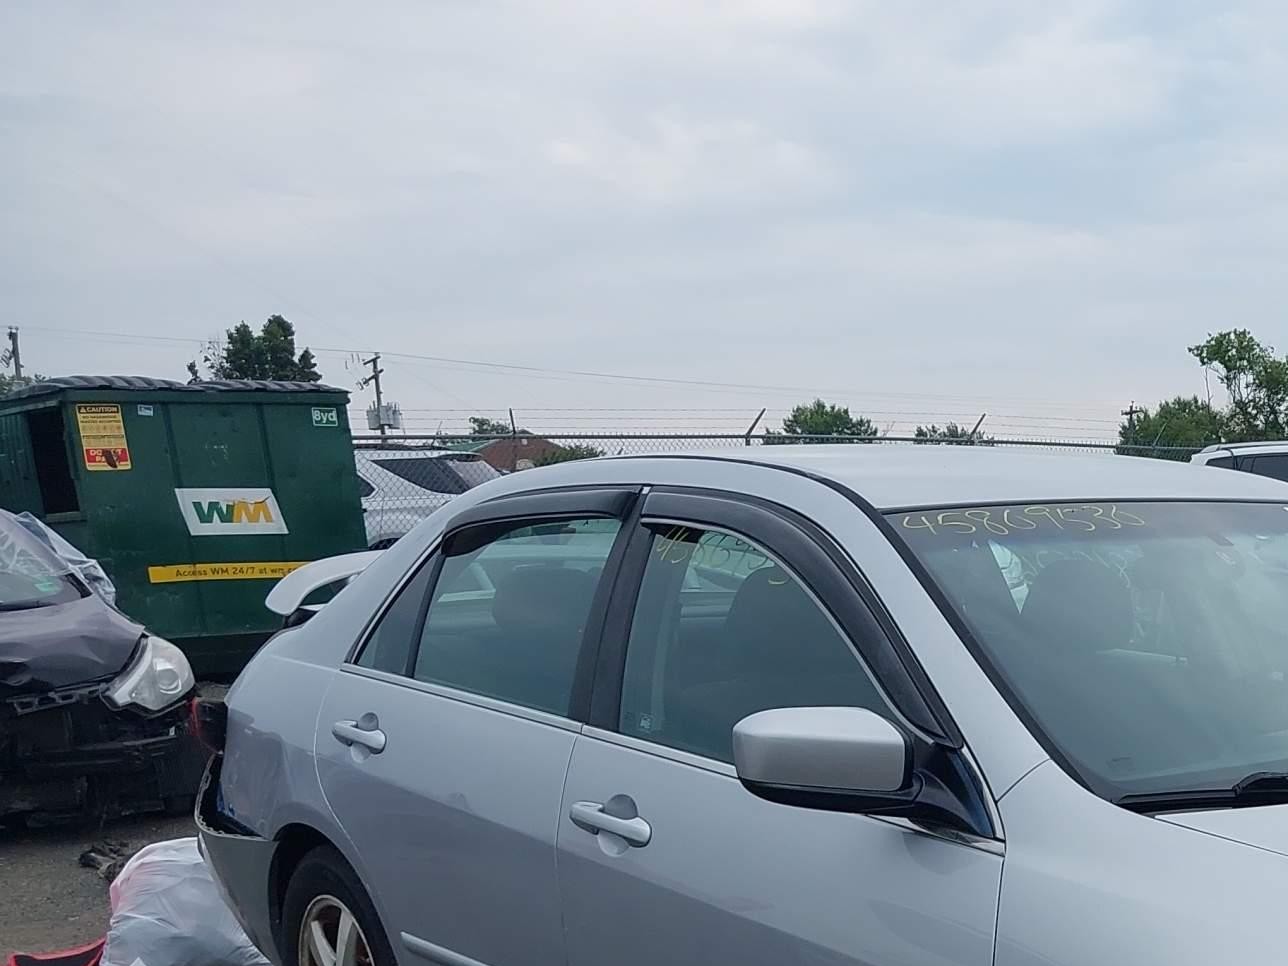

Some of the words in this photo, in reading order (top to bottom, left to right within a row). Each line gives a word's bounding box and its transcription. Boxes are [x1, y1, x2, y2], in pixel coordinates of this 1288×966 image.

[313, 410, 337, 423] 8yd
[191, 501, 273, 524] WM
[903, 504, 1145, 535] 45869536
[175, 569, 208, 578] Access
[210, 567, 229, 576] WM
[232, 566, 256, 575] 24/7
